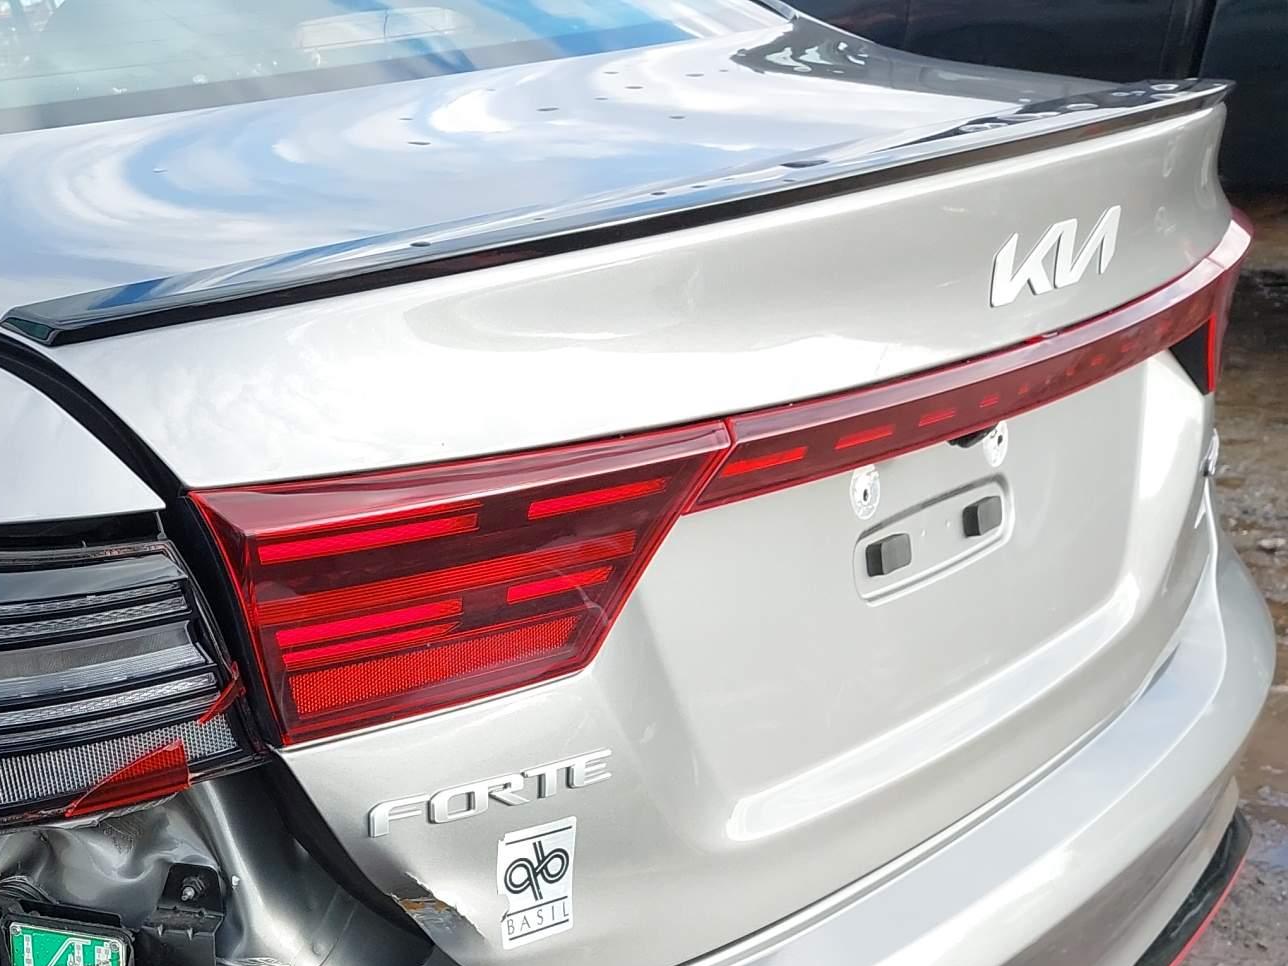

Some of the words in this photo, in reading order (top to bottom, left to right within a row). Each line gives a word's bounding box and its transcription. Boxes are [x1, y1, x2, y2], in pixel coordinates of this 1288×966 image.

[990, 205, 1121, 308] KIA
[368, 747, 612, 838] FORTE
[507, 901, 569, 936] BASIL
